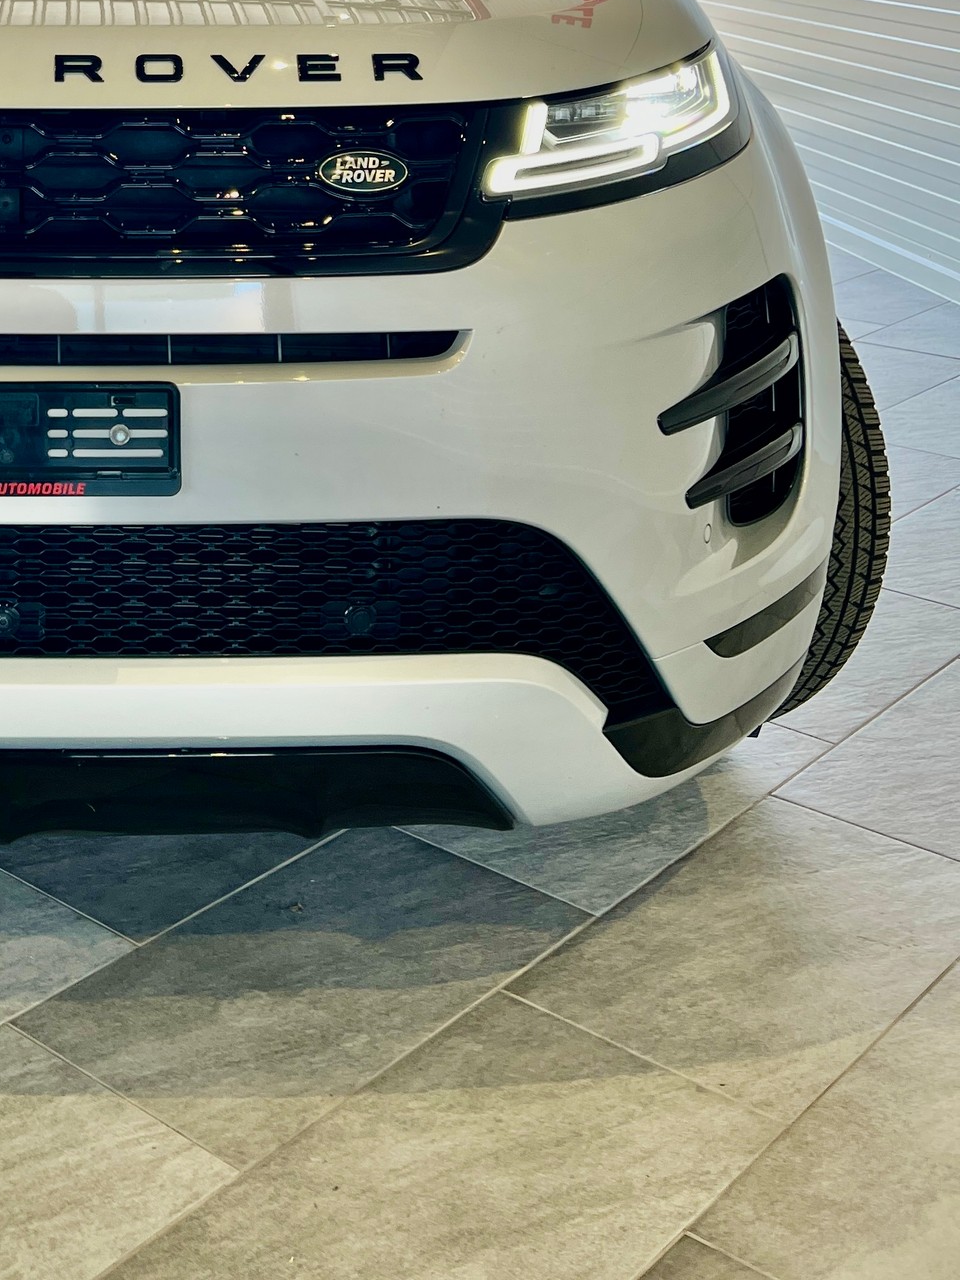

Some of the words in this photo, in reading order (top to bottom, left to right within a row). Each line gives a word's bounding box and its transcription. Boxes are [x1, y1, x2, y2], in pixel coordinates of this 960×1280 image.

[53, 53, 424, 83] ROVER
[335, 155, 380, 170] LAND
[341, 169, 396, 184] ROVER
